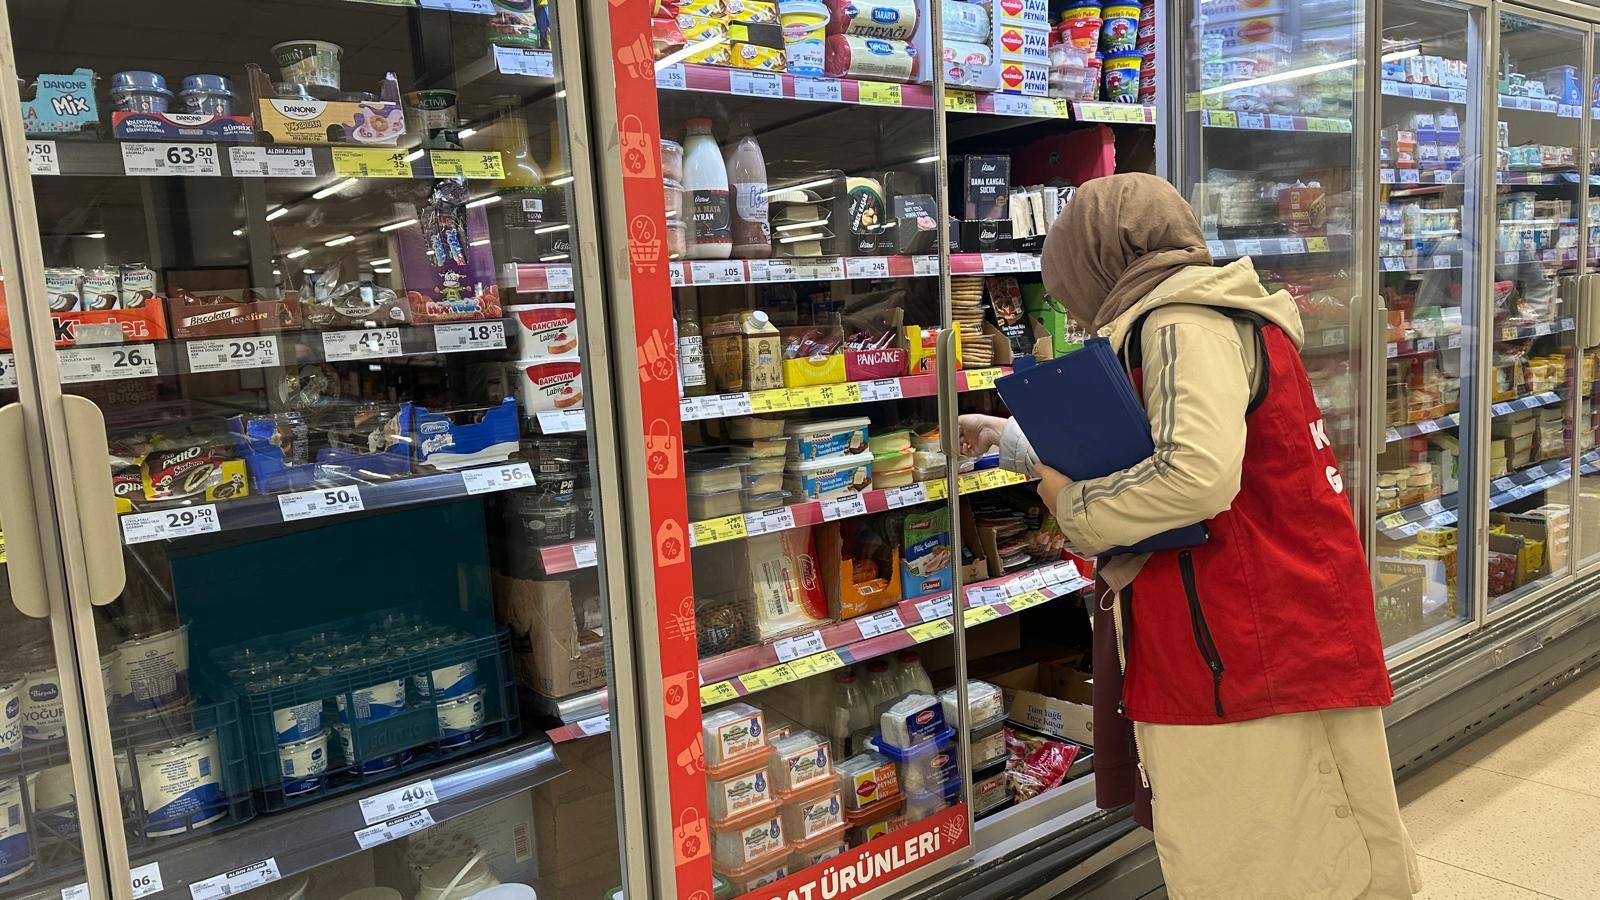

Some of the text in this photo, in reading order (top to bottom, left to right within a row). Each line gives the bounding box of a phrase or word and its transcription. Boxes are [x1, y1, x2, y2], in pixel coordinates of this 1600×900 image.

[1024, 12, 1047, 21] PEYNİRİ
[851, 25, 907, 39] TEREYAĞI
[1025, 34, 1046, 46] TAVA
[1024, 47, 1047, 57] PEYNİRİ
[1025, 70, 1046, 82] TAVA
[1024, 82, 1047, 92] PEYNİRİ
[51, 93, 90, 116] Mix
[971, 178, 1005, 186] DANA KANGAL
[980, 186, 996, 194] SUCUK
[190, 310, 231, 326] Biscolata
[359, 330, 398, 348] 42,50
[468, 325, 503, 341] 18,95
[229, 340, 272, 358] 29,50
[112, 349, 143, 367] 26
[857, 350, 900, 366] PANCAKE
[501, 467, 524, 482] 56
[324, 490, 350, 505] 50
[166, 508, 212, 528] 29,50
[402, 786, 425, 802] 40
[821, 827, 940, 900] ÜRÜNLERİ
[258, 869, 272, 877] 75
